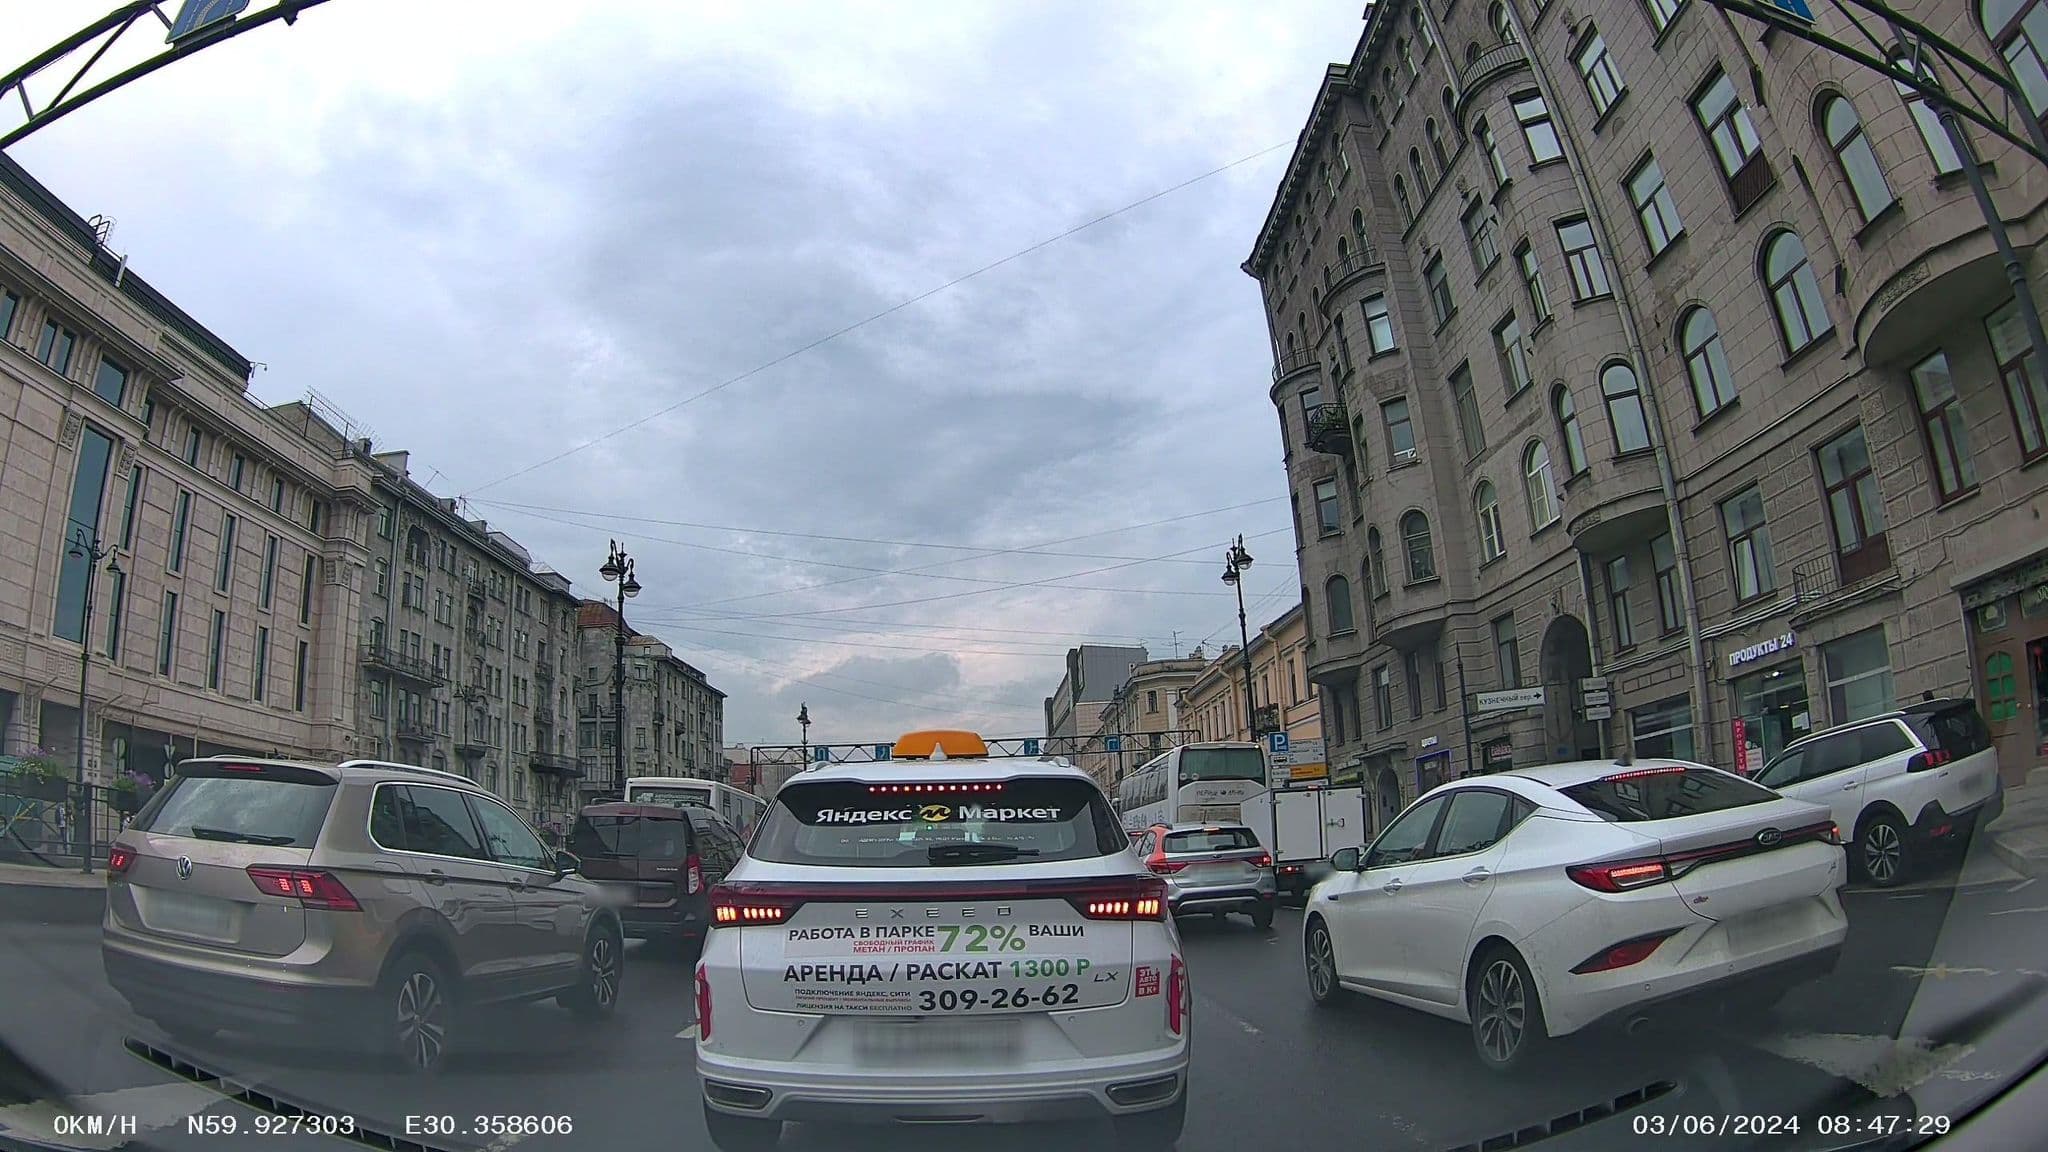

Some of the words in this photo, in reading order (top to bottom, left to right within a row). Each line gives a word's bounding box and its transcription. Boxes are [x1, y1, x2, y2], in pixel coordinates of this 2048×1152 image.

[1729, 638, 1778, 666] ПРОДУКТЫ
[1780, 632, 1794, 649] 24
[816, 807, 912, 823] Яндекс
[959, 805, 1061, 821] Маркет
[855, 906, 1012, 918] EXEED
[789, 928, 855, 941] РАБОТА
[860, 926, 870, 938] В
[876, 926, 935, 938] ПАРКЕ
[937, 924, 1026, 953] 72%
[1029, 924, 1085, 937] ВАШИ
[784, 964, 883, 985] АРЕНДА
[889, 963, 899, 982] /
[906, 962, 1002, 981] РАСКАТ
[1010, 959, 1069, 978] 1300
[1094, 971, 1119, 983] LX
[795, 988, 854, 997] ПОДКЛЮЧЕНИЕ
[918, 983, 1080, 1011] 309-26-62
[796, 1002, 833, 1010] ЛИЦЕНЗИЯ
